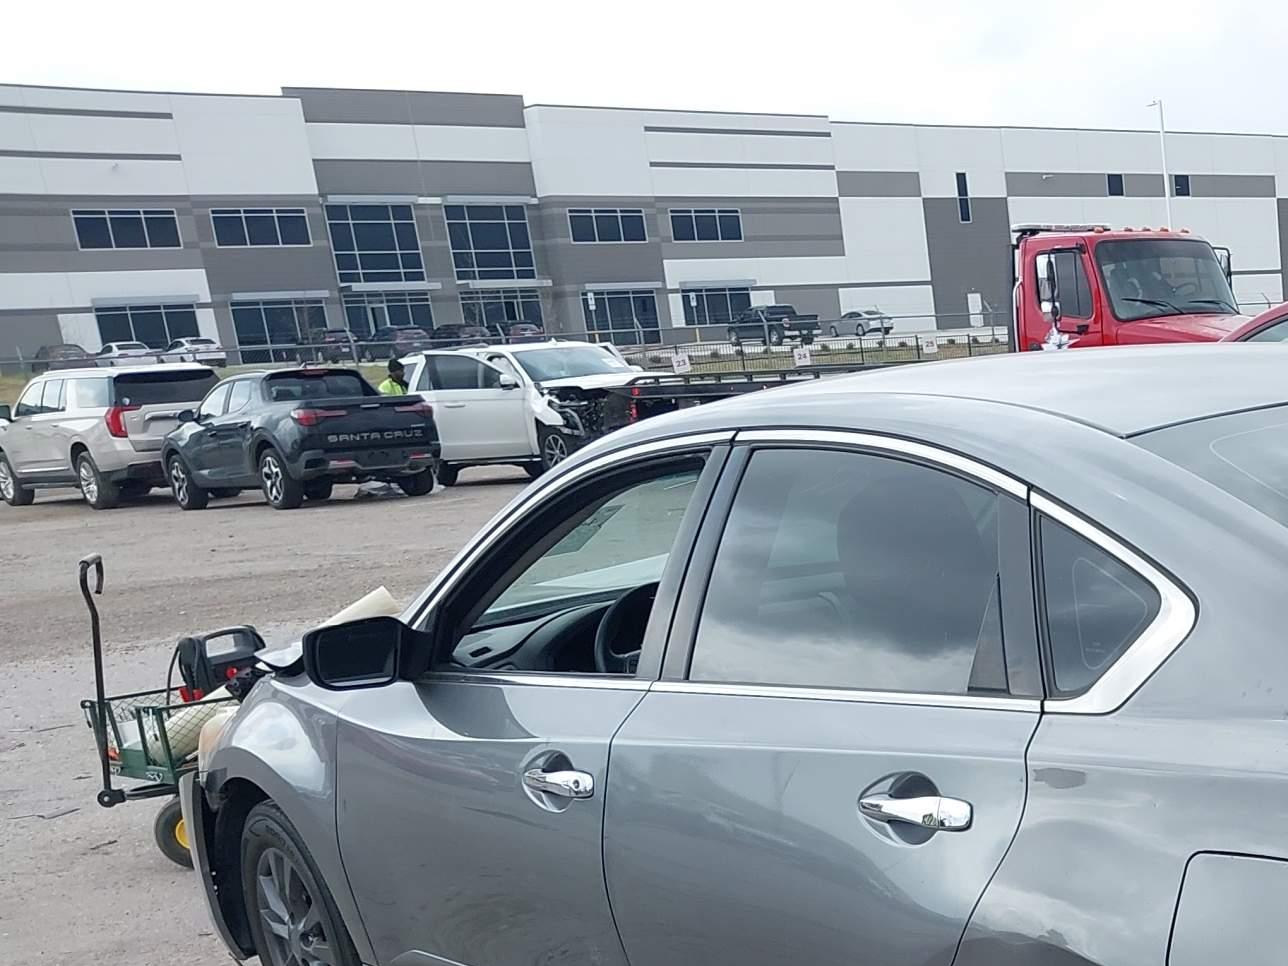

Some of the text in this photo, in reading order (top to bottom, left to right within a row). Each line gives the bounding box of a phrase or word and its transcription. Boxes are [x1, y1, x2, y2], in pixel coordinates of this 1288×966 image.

[797, 352, 807, 360] 24
[676, 360, 686, 368] 23
[327, 429, 424, 443] SANTA CRUZ
